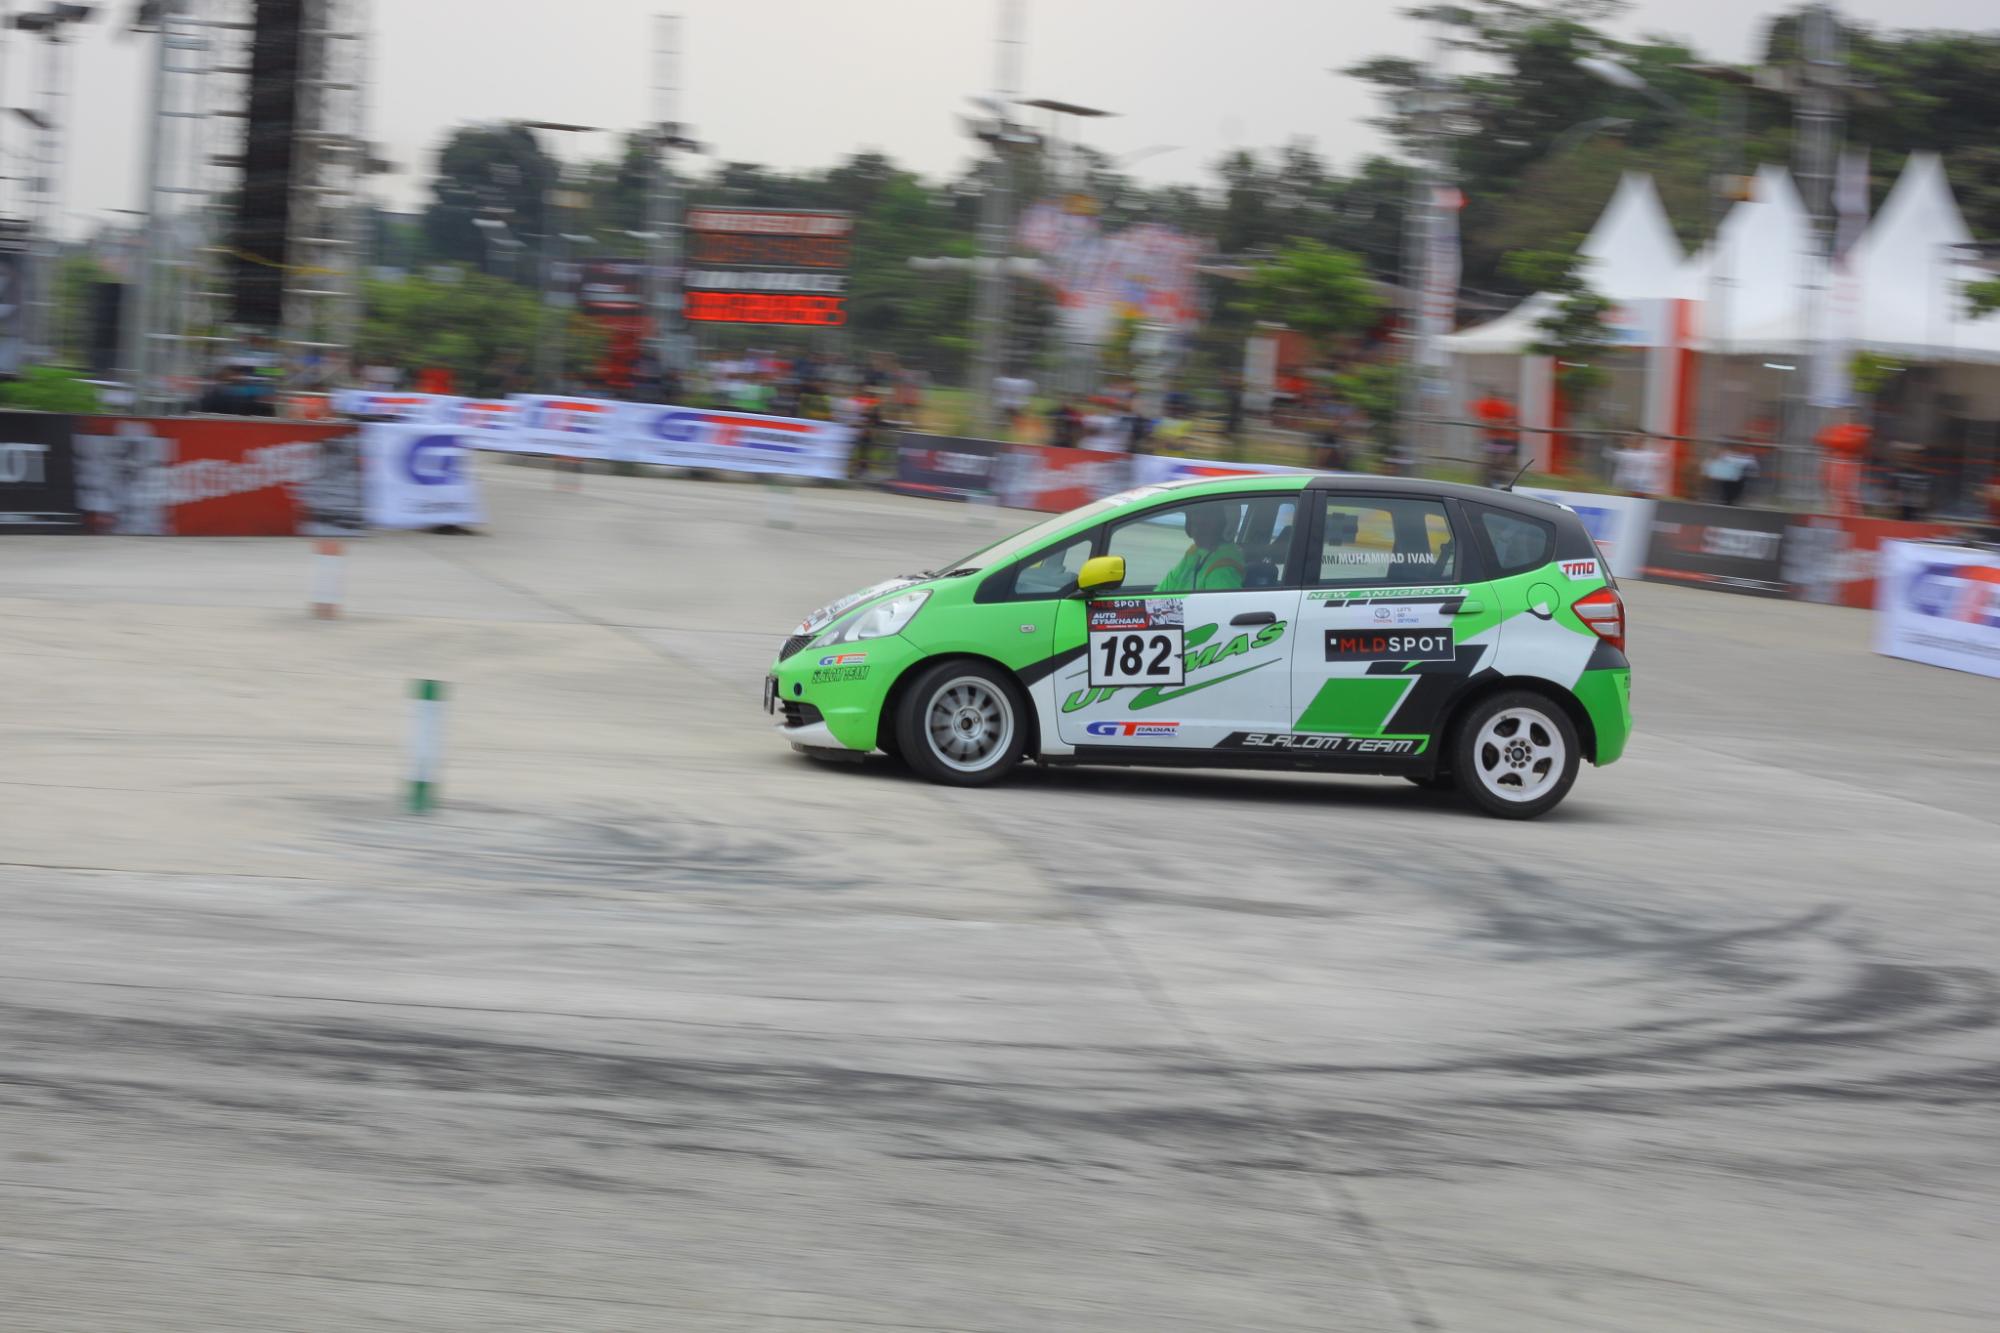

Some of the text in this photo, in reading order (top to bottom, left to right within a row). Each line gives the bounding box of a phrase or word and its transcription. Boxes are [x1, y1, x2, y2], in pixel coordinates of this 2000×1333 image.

[1339, 551, 1405, 564] MUHAMMAD
[1407, 552, 1434, 564] IVAN
[1308, 587, 1462, 600] NEW ANUGERAH
[1339, 636, 1447, 654] MLDSPOT
[1100, 634, 1172, 677] 182
[1242, 733, 1413, 753] SLALOM TEAM
